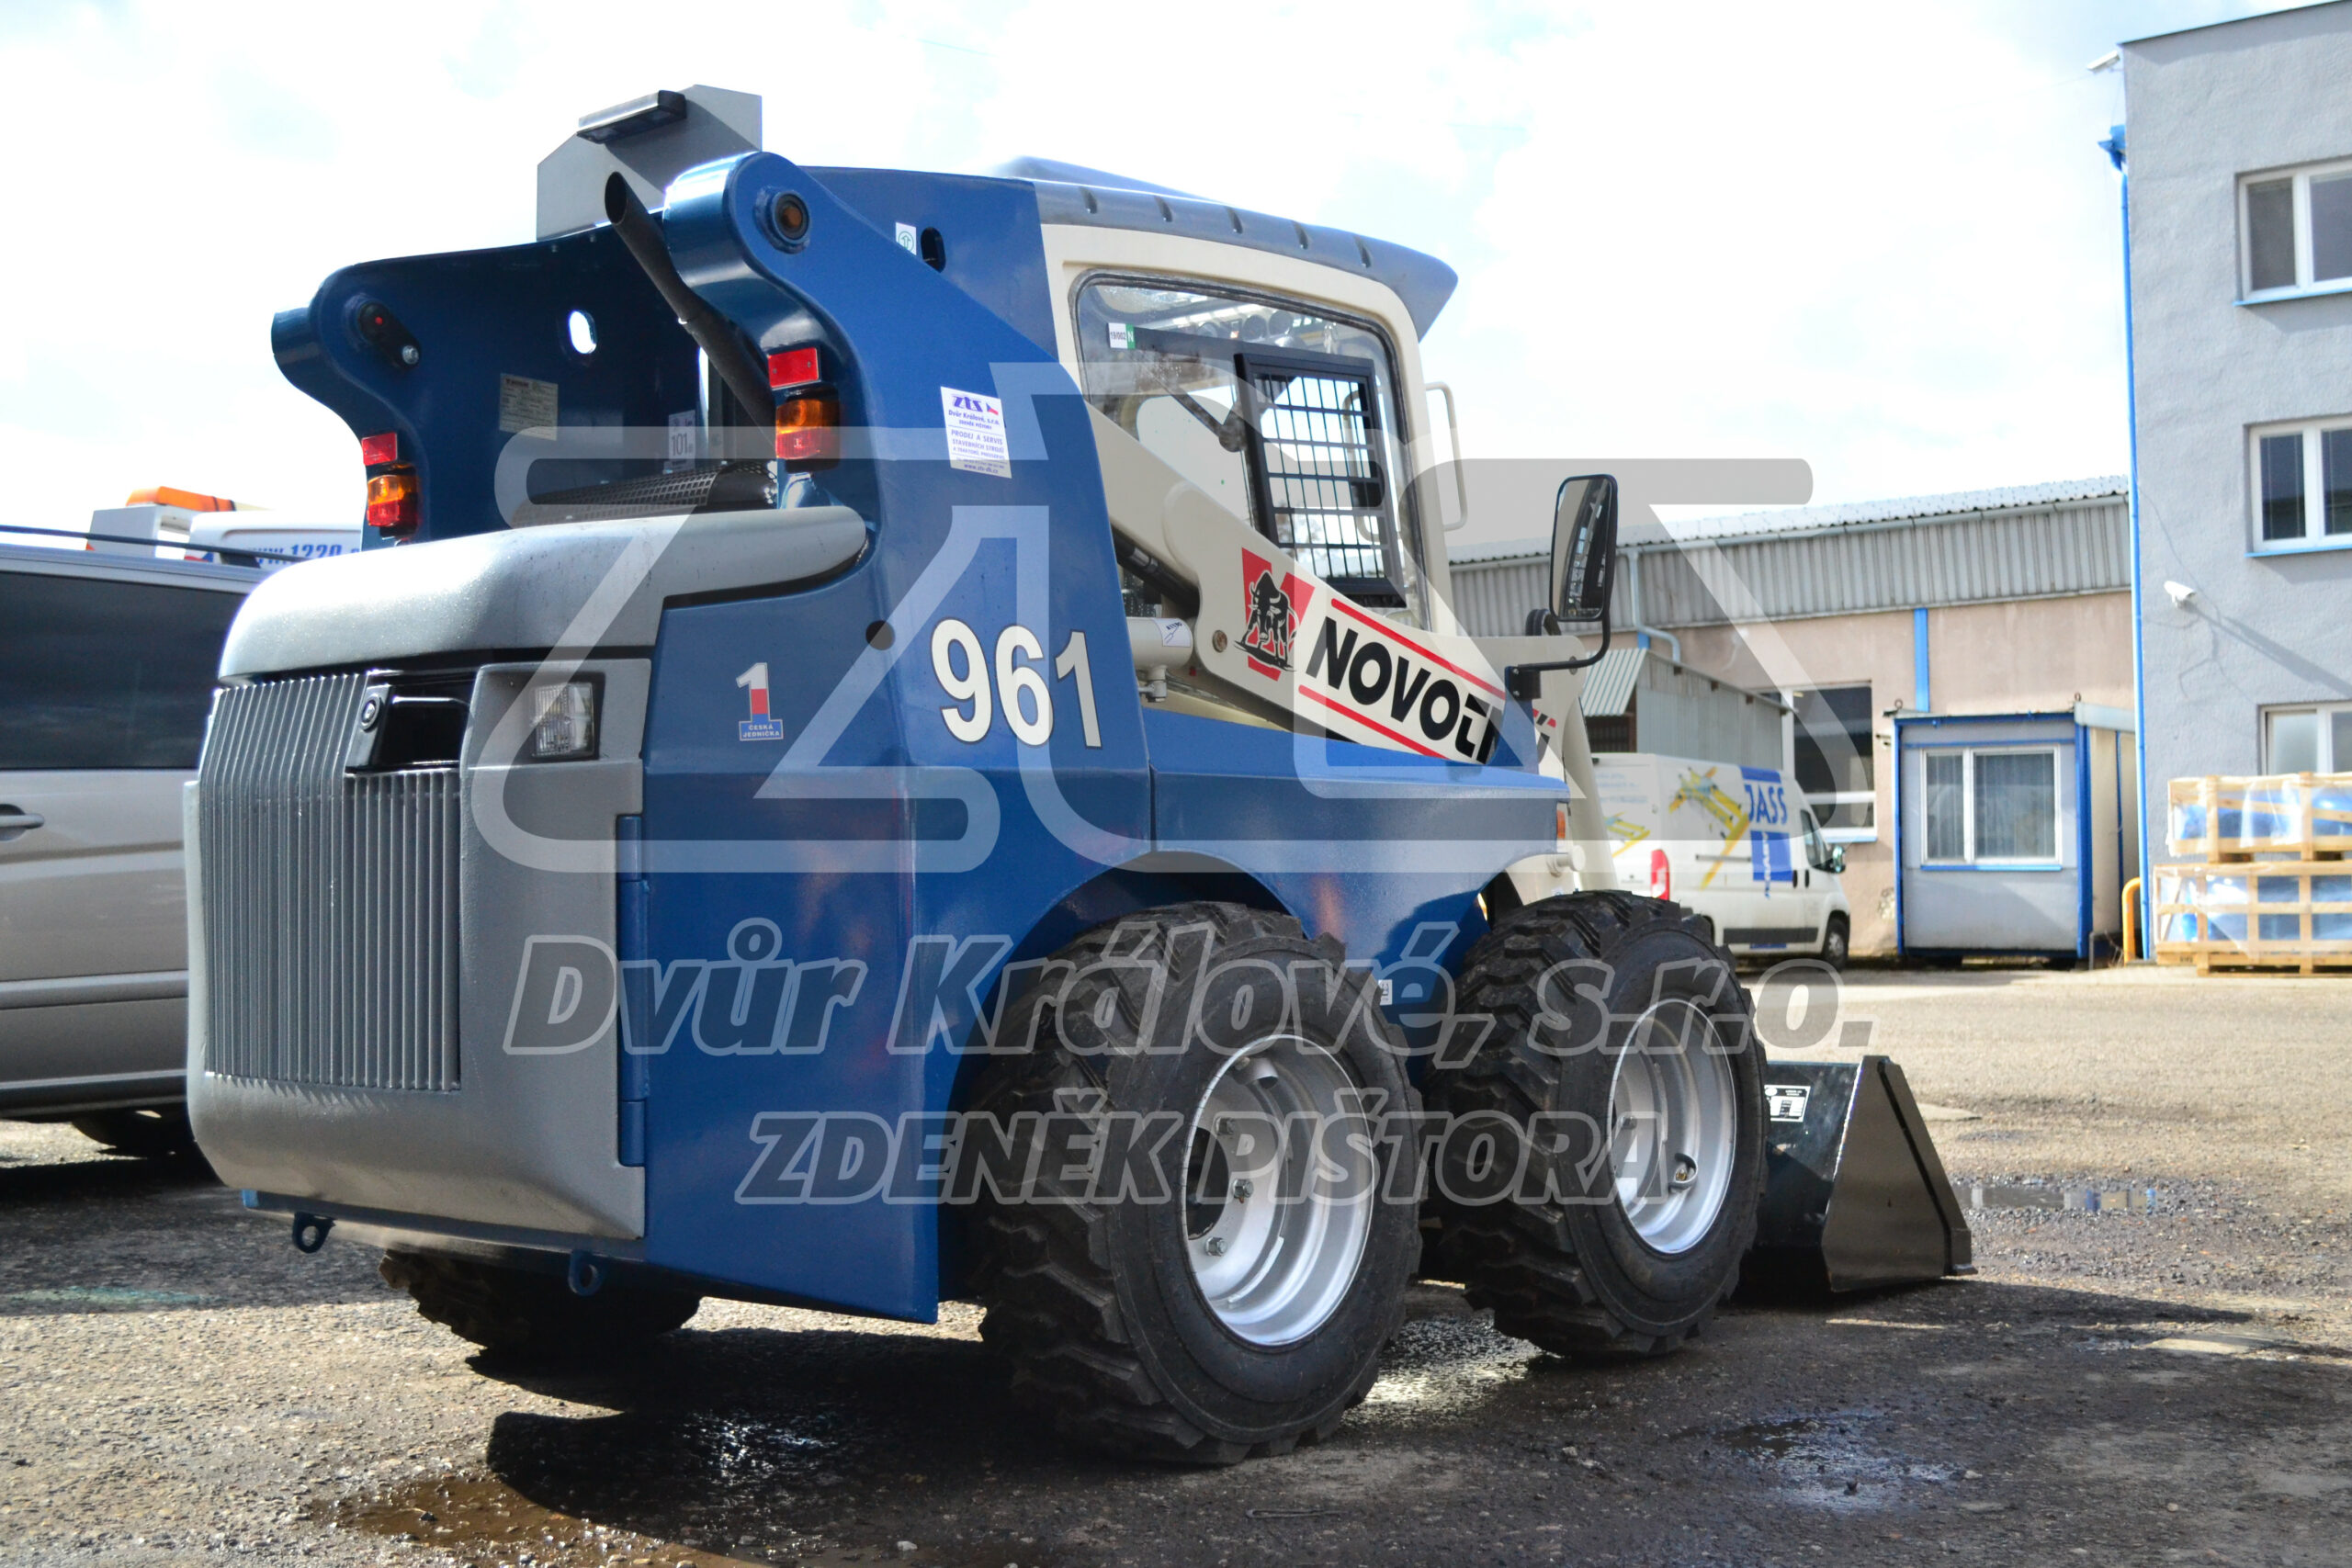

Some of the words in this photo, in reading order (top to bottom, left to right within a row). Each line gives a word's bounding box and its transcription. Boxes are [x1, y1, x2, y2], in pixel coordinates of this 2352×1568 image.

[672, 433, 688, 457] 101
[951, 429, 974, 440] PRODEJ
[983, 435, 1003, 446] SERVIS
[931, 617, 1102, 749] 961
[748, 722, 775, 731] ČESKÁ
